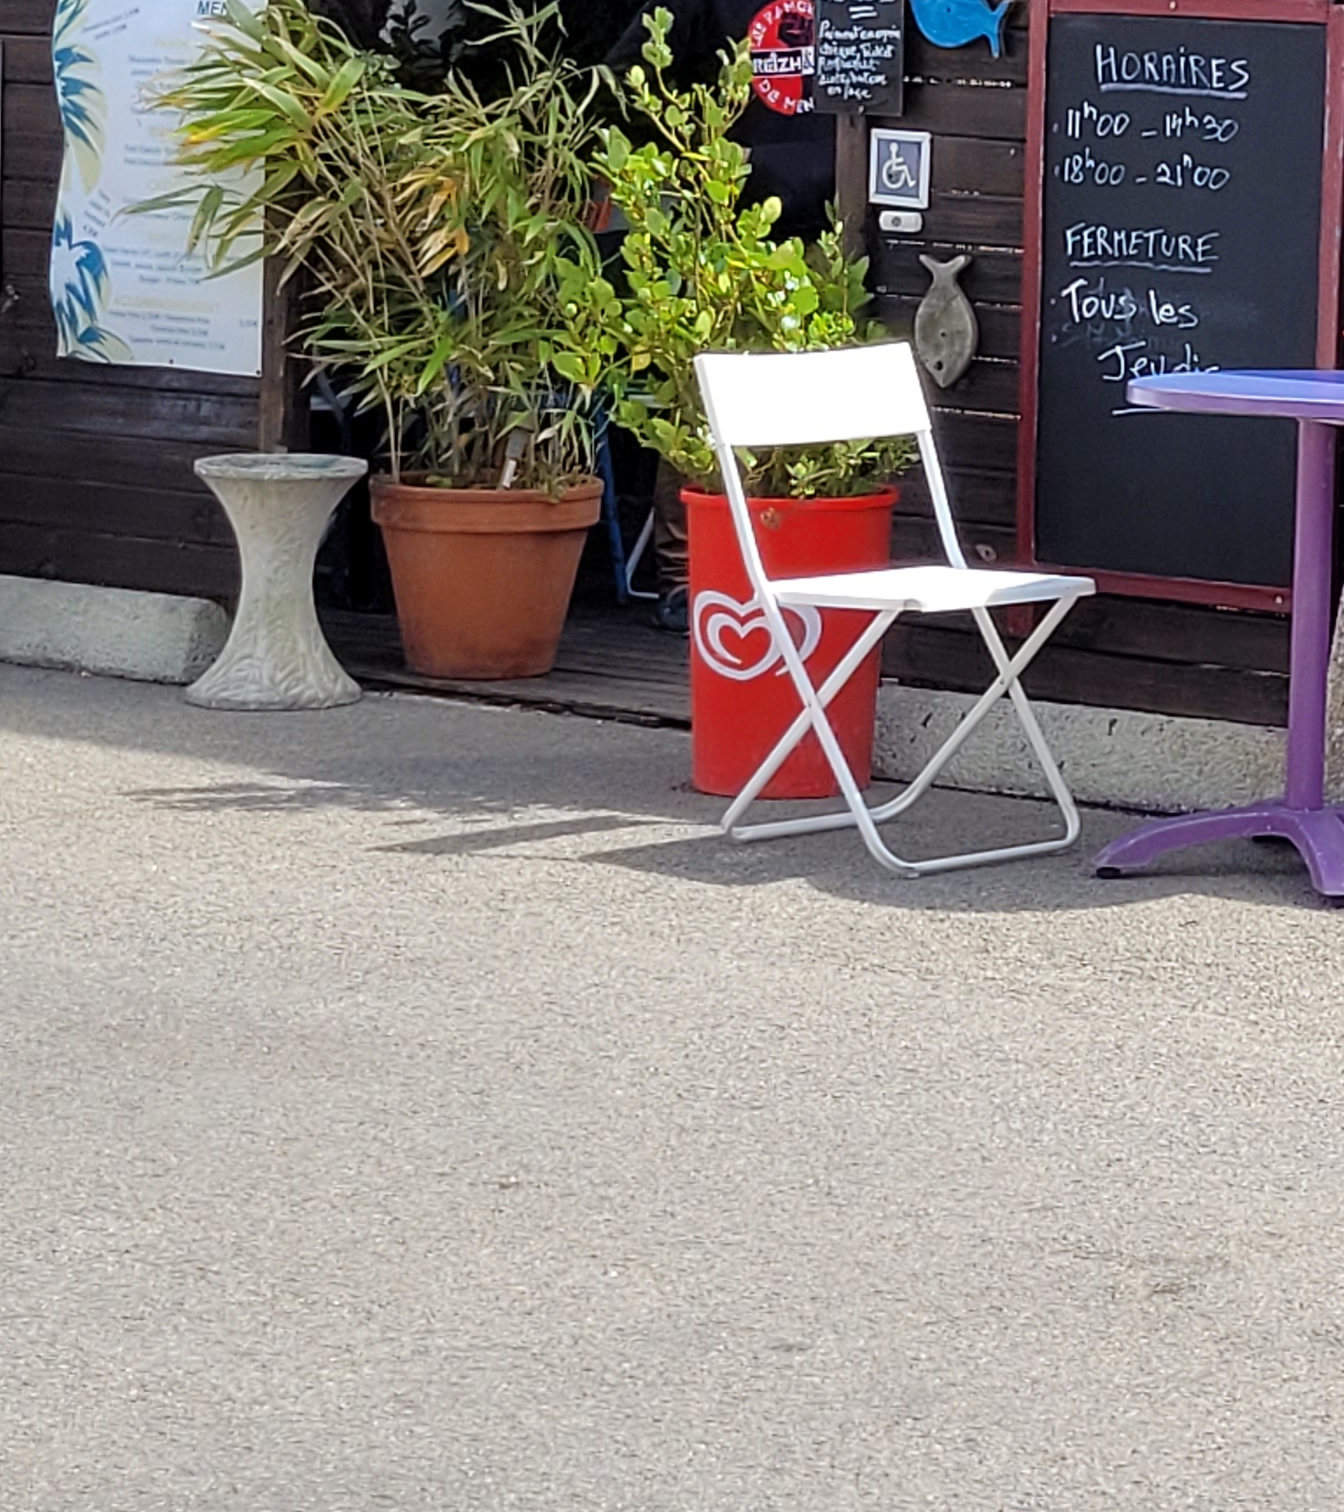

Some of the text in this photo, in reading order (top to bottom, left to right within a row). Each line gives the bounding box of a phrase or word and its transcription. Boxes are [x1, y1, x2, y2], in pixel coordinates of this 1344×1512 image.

[197, 0, 229, 15] MEN
[1063, 151, 1125, 186] 18h00
[1066, 221, 1220, 264] FERMETURE
[1061, 278, 1199, 329] Tous les
